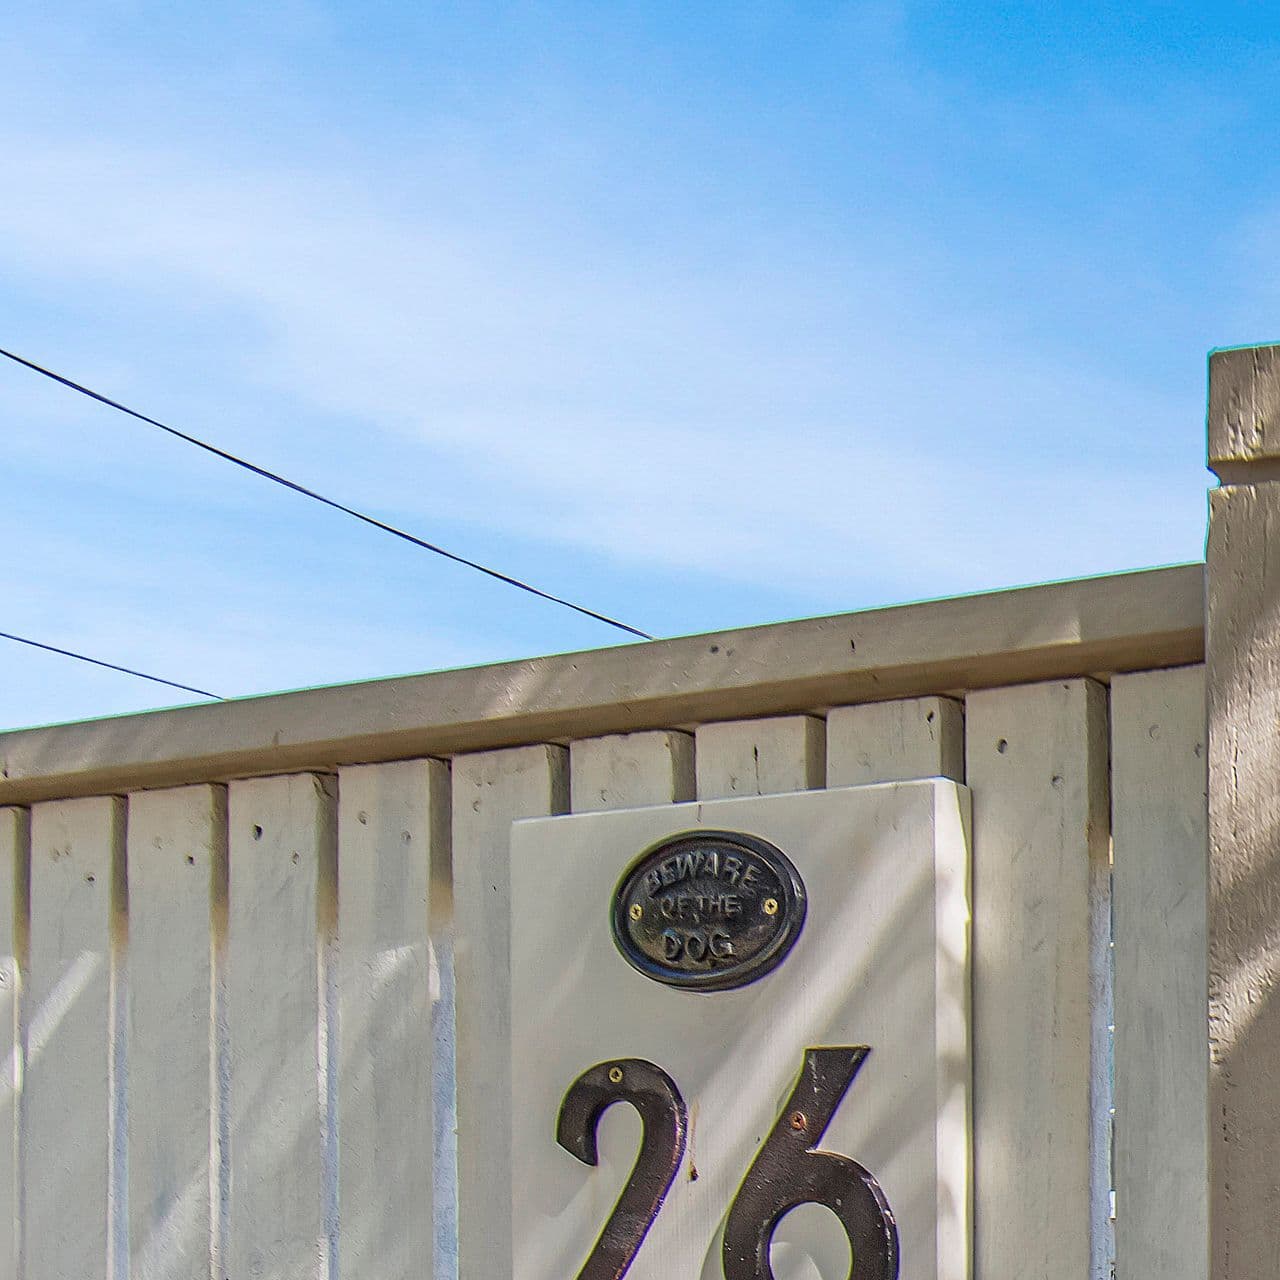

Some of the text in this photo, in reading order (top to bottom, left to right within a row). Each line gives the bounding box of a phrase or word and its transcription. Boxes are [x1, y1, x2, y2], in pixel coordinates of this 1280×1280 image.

[646, 851, 762, 893] BEWARE
[660, 895, 741, 920] OF THE
[664, 930, 736, 961] DOG
